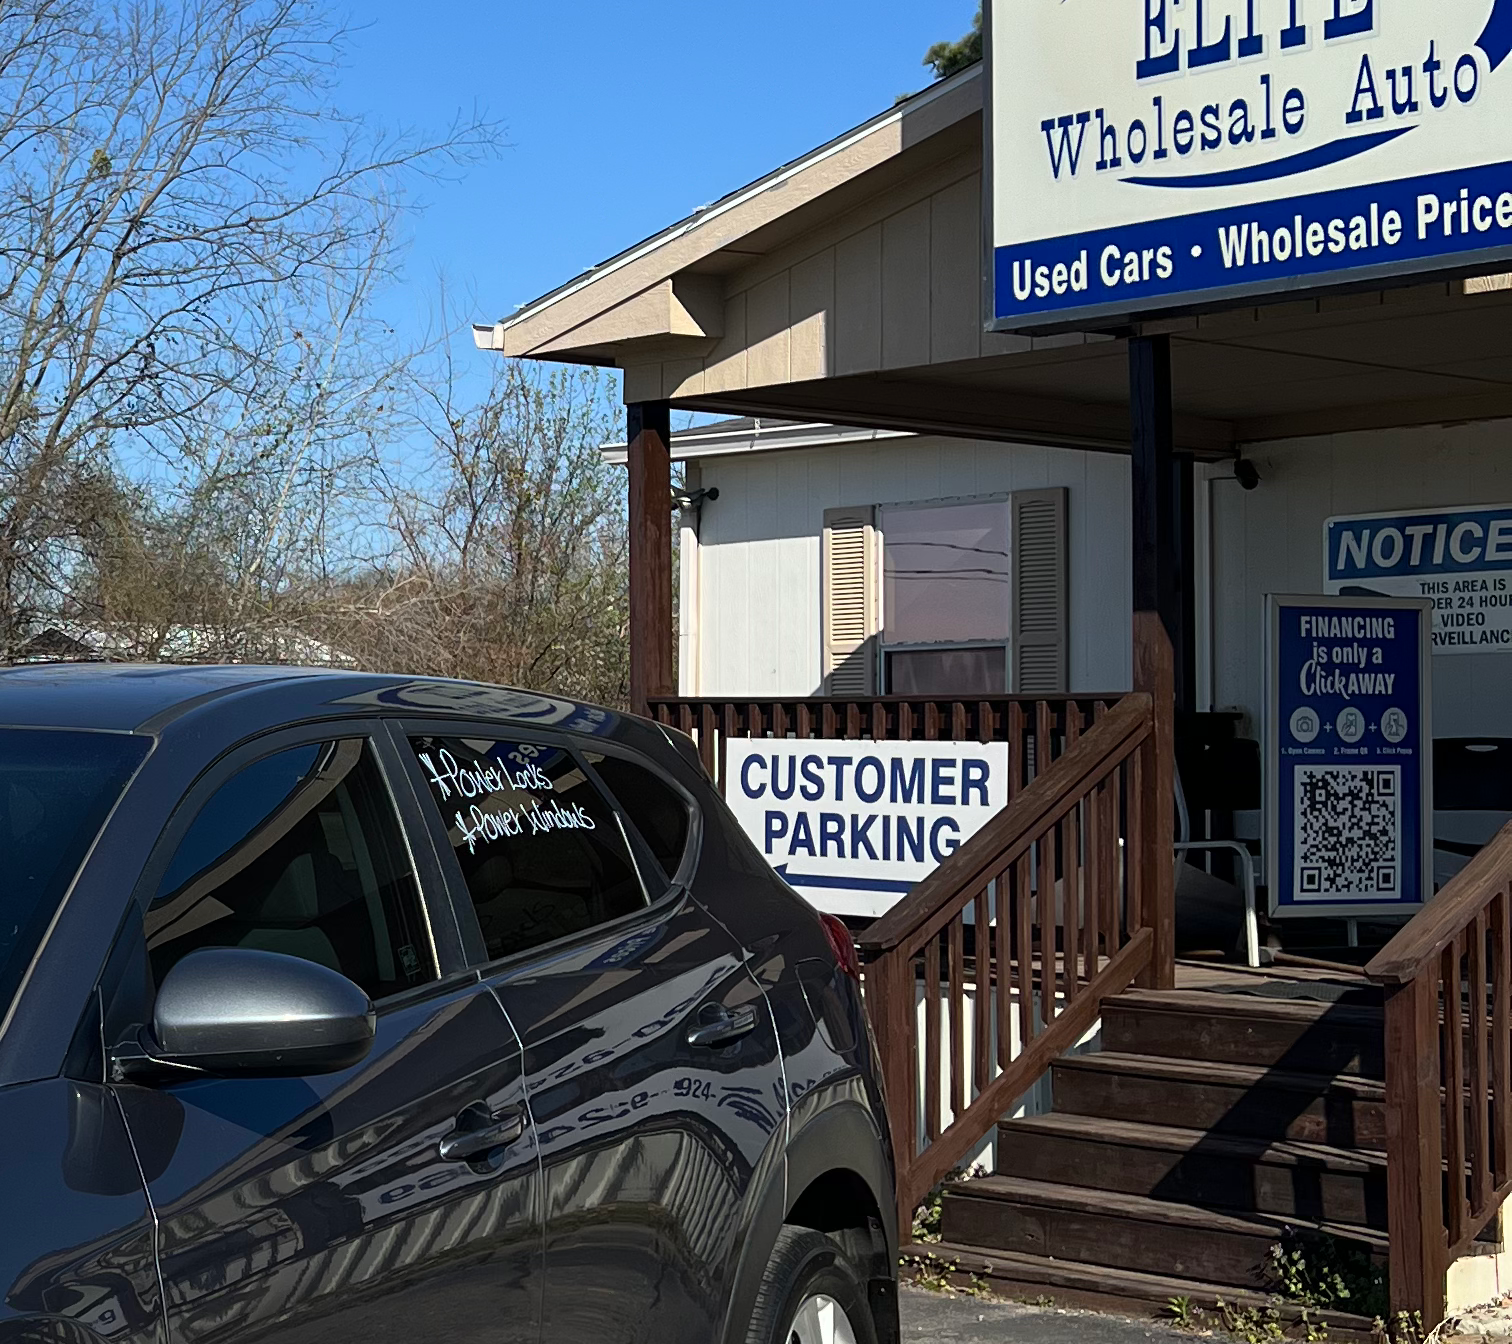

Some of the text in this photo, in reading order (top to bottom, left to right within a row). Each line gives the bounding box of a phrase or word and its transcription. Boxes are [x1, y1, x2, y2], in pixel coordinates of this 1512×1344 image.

[1040, 39, 1478, 179] Wholesale Auto
[1011, 250, 1088, 301] Used
[1100, 243, 1174, 287] Cars
[1217, 202, 1402, 269] Wholesale
[1336, 518, 1512, 571] NOTICE
[1419, 578, 1507, 595] THIS AREA IS
[1431, 597, 1454, 610] DER
[1457, 595, 1475, 609] 24
[1300, 616, 1395, 638] FINANCING
[1431, 628, 1512, 646] RVEILLANC
[1440, 611, 1486, 628] VIDEO
[1313, 641, 1383, 669] is only a
[497, 756, 554, 791] Locks
[739, 752, 990, 808] CUSTOMER
[520, 799, 596, 836] Windows
[763, 810, 962, 863] PARKING
